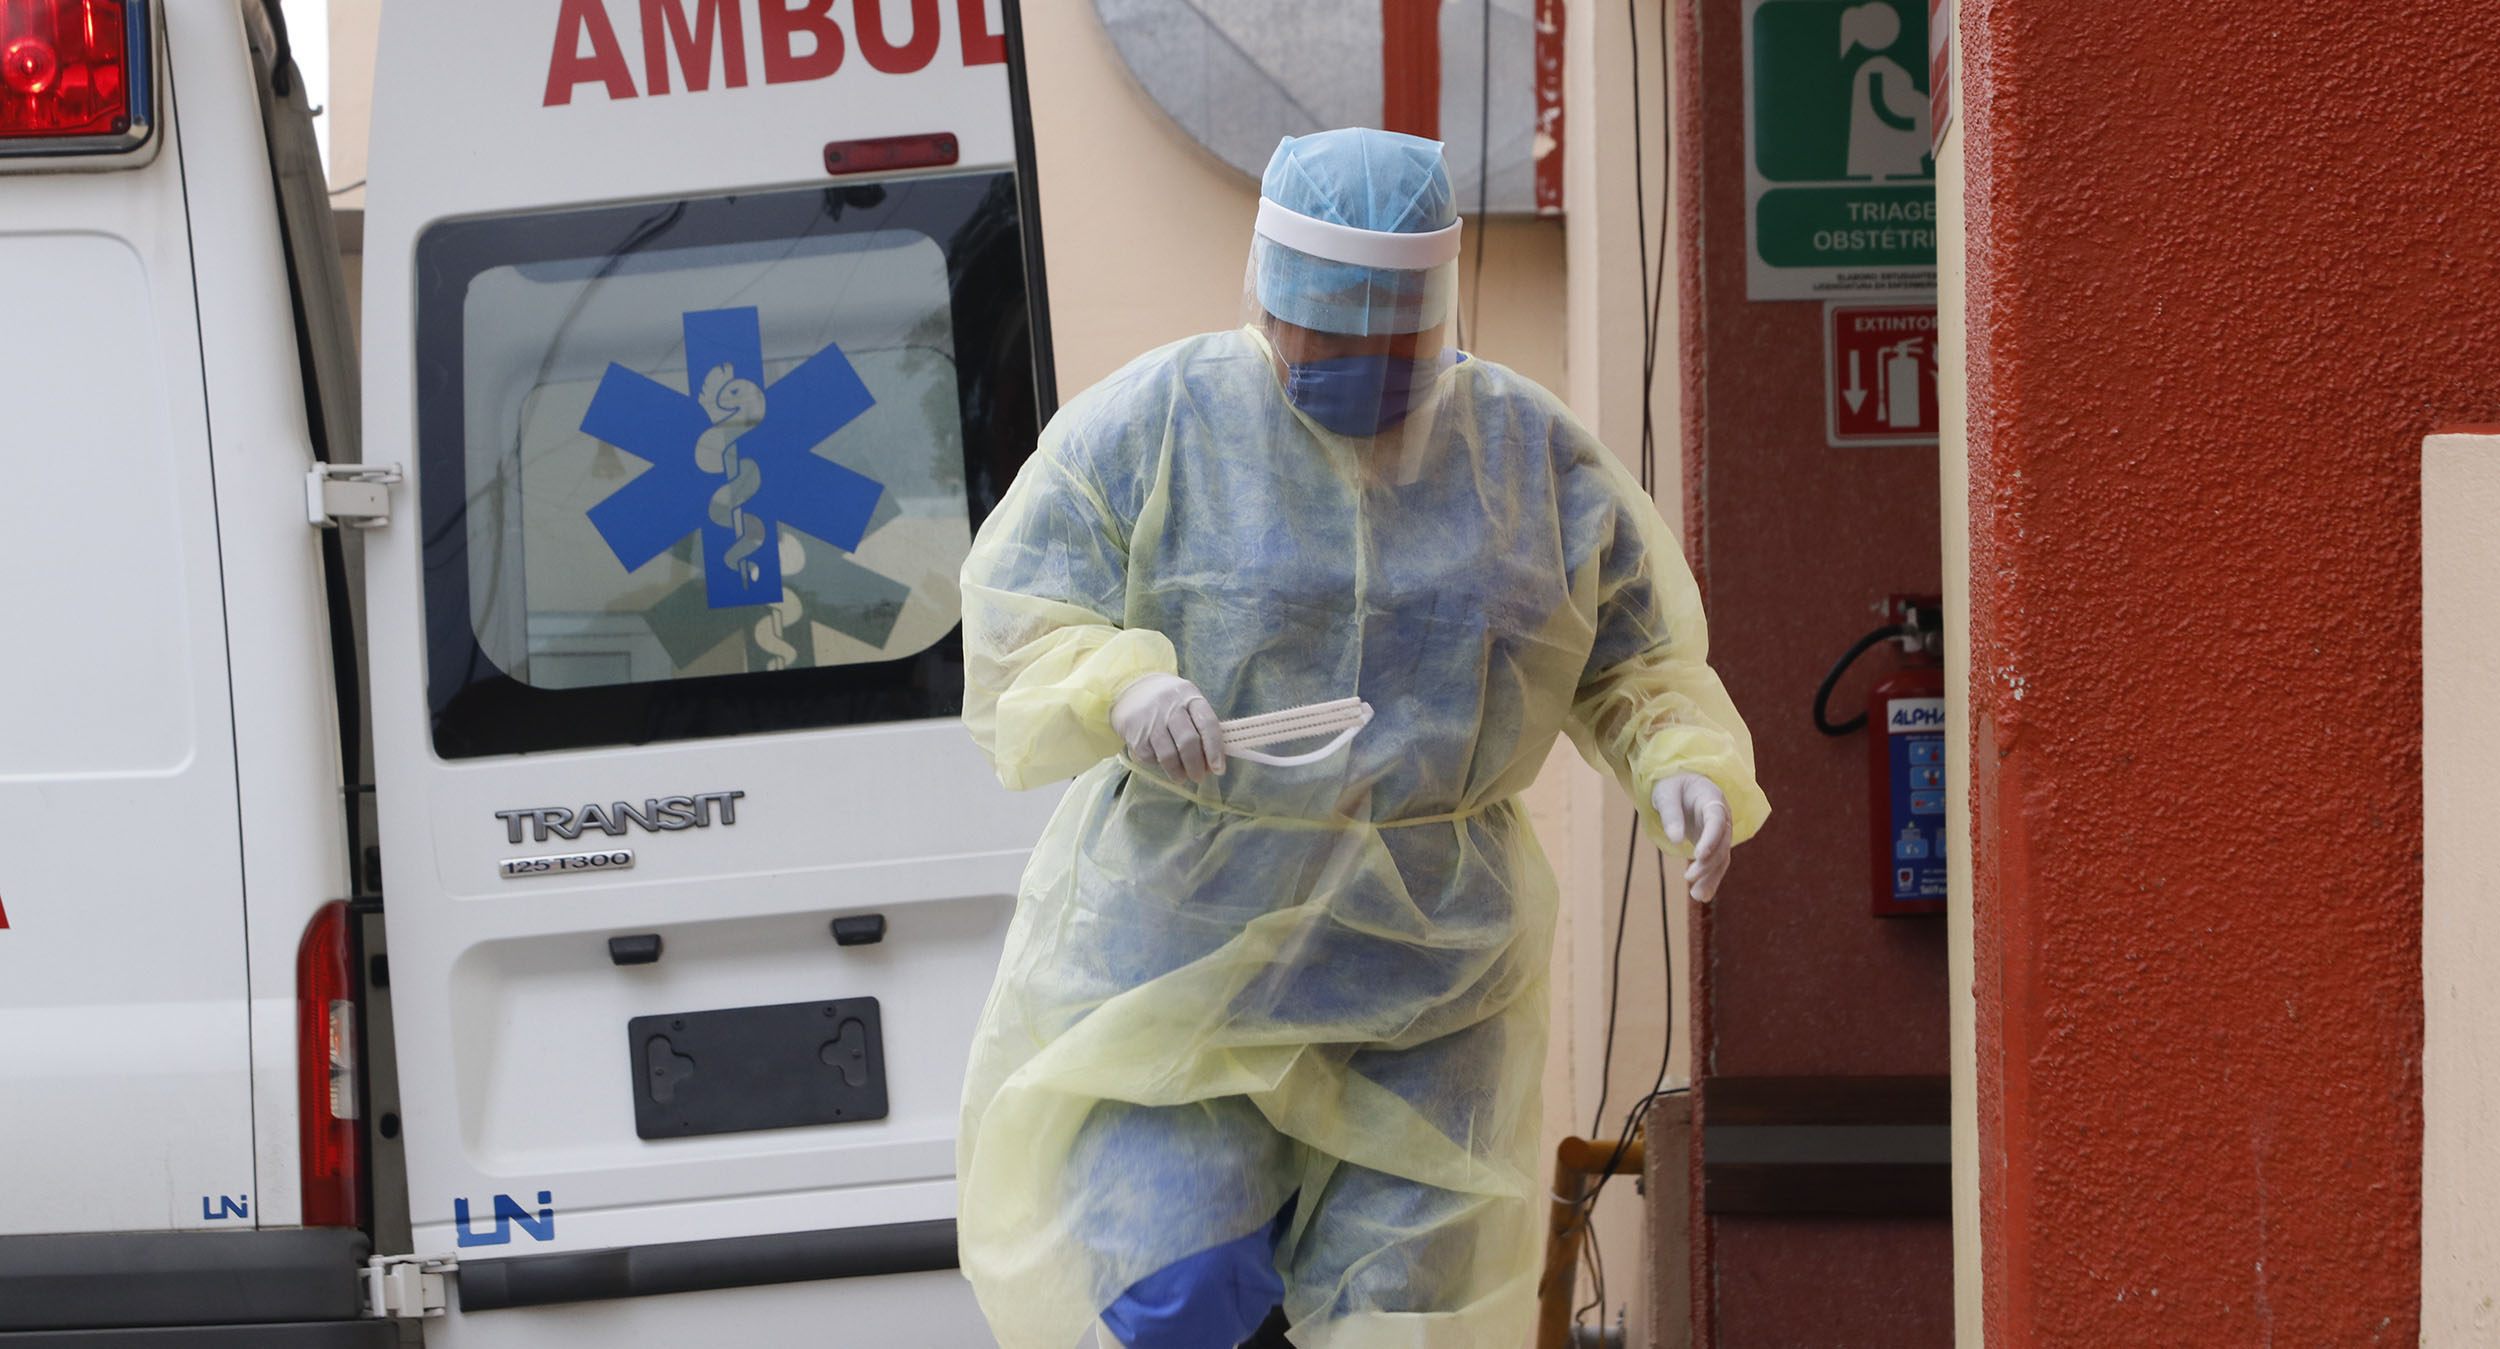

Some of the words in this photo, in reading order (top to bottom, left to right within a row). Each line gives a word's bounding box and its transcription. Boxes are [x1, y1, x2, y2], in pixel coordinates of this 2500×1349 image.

[1847, 201, 1936, 221] TRIAGE
[1813, 226, 1936, 250] OBSTÉTRI
[494, 790, 745, 844] TRANSIT
